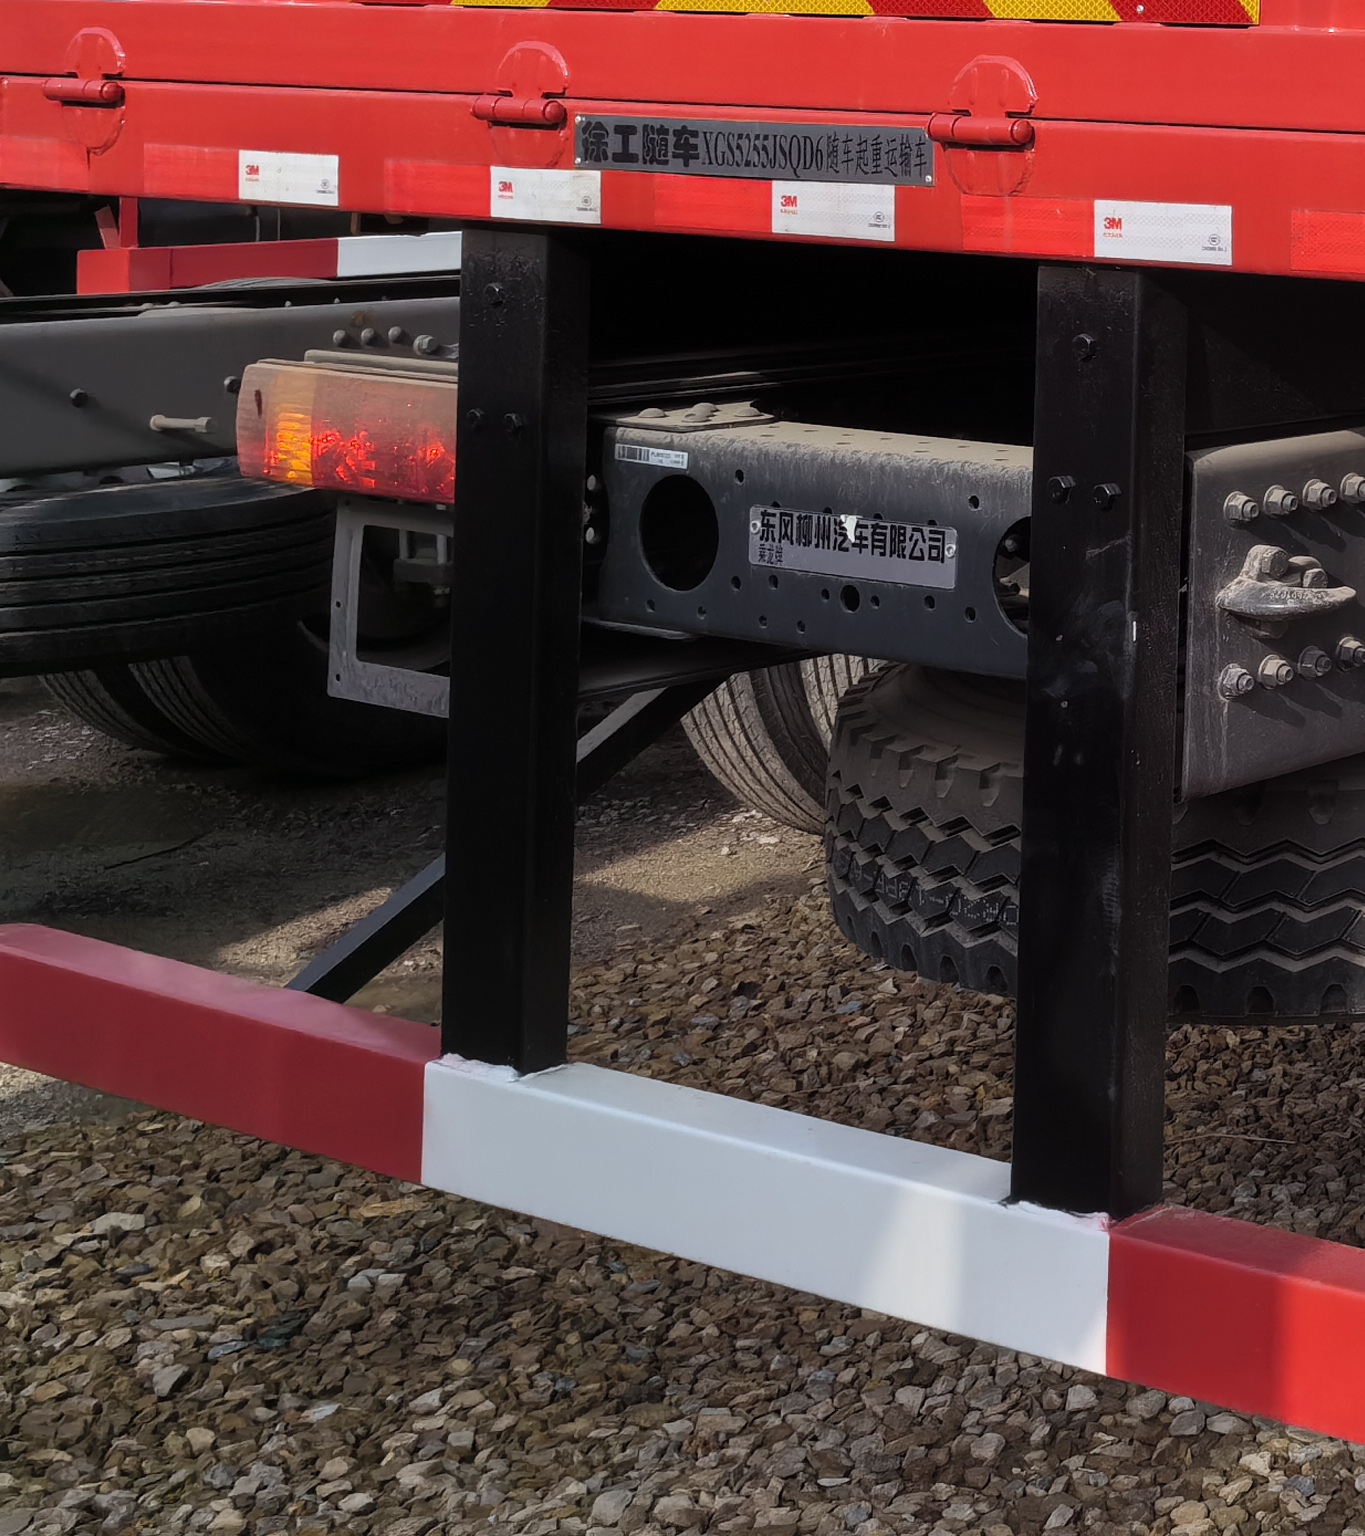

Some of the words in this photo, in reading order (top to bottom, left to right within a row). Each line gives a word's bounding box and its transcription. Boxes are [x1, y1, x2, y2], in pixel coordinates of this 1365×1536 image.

[246, 165, 260, 176] 3M
[499, 181, 513, 193] 3M
[780, 195, 797, 208] 3M
[1104, 217, 1122, 230] 3M
[759, 510, 946, 564] 东风柳州汽车有限公司
